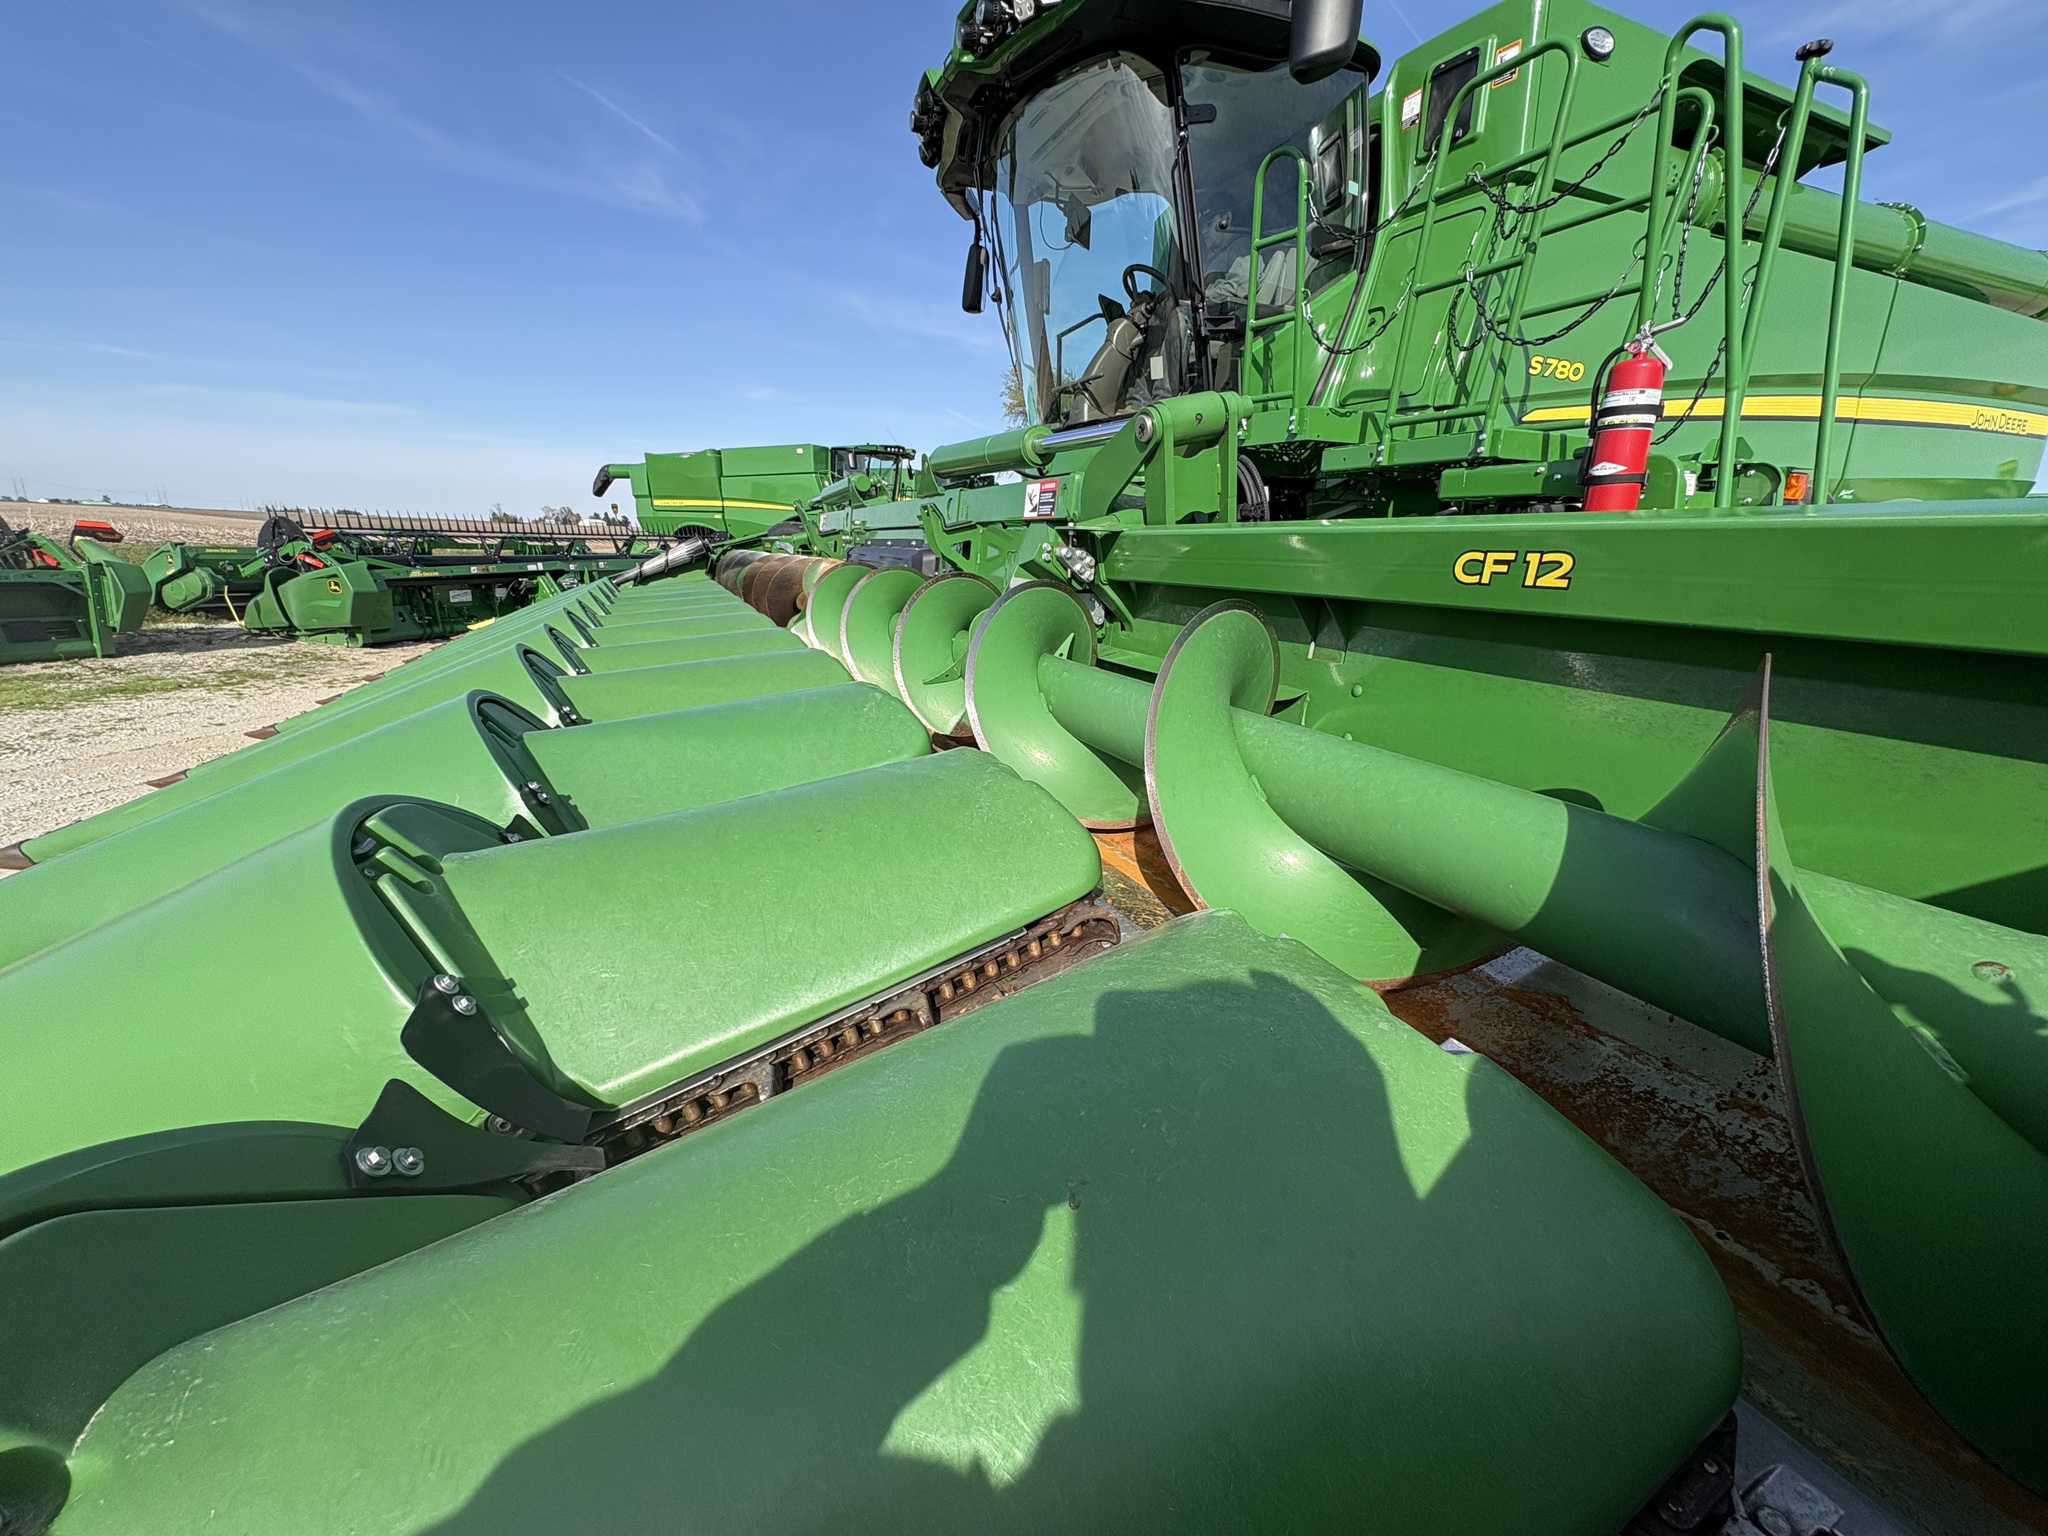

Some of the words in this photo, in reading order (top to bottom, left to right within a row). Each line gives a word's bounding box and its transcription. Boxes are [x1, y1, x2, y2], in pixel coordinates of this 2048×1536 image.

[1528, 355, 1585, 382] S780
[1971, 409, 1998, 428] JOHN
[1998, 413, 2028, 433] DEERE
[1453, 551, 1517, 586] CF
[1522, 551, 1575, 590] 12
